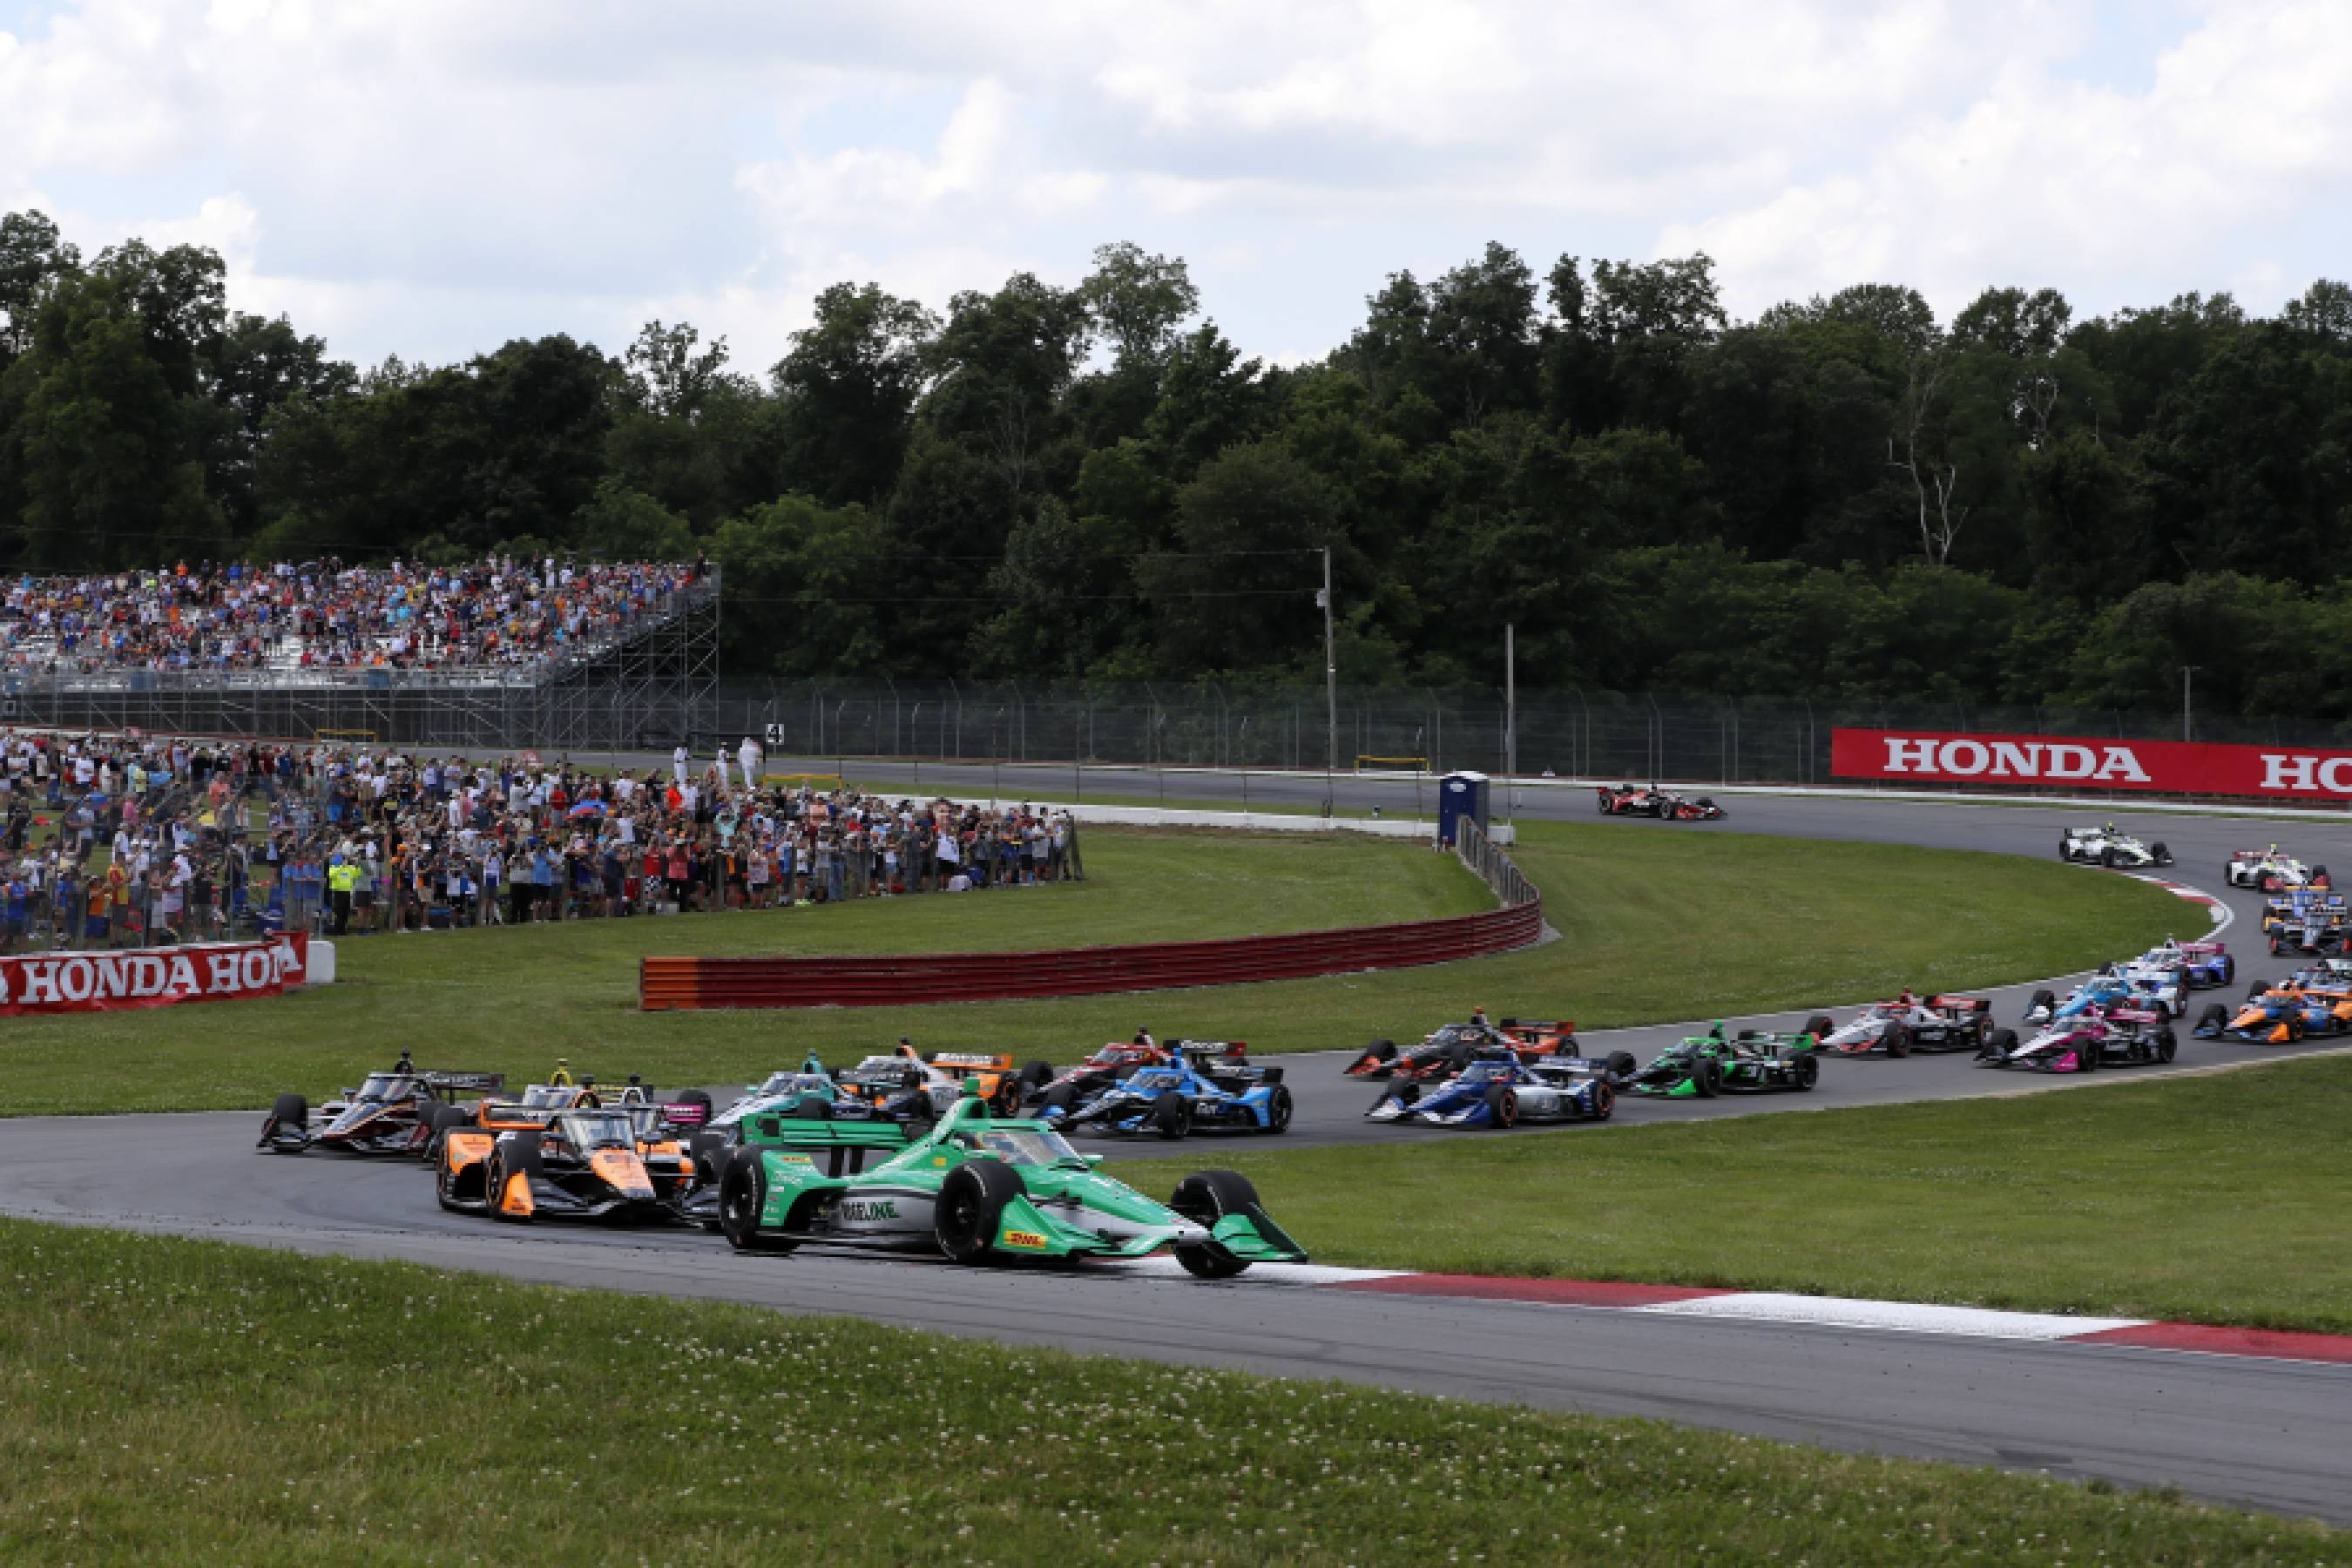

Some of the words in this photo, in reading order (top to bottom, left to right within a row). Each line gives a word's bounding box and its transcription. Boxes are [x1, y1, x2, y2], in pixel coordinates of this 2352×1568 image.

[1884, 739, 2152, 781] HONDA
[2261, 754, 2352, 792] HO
[18, 956, 201, 1004] HONDA
